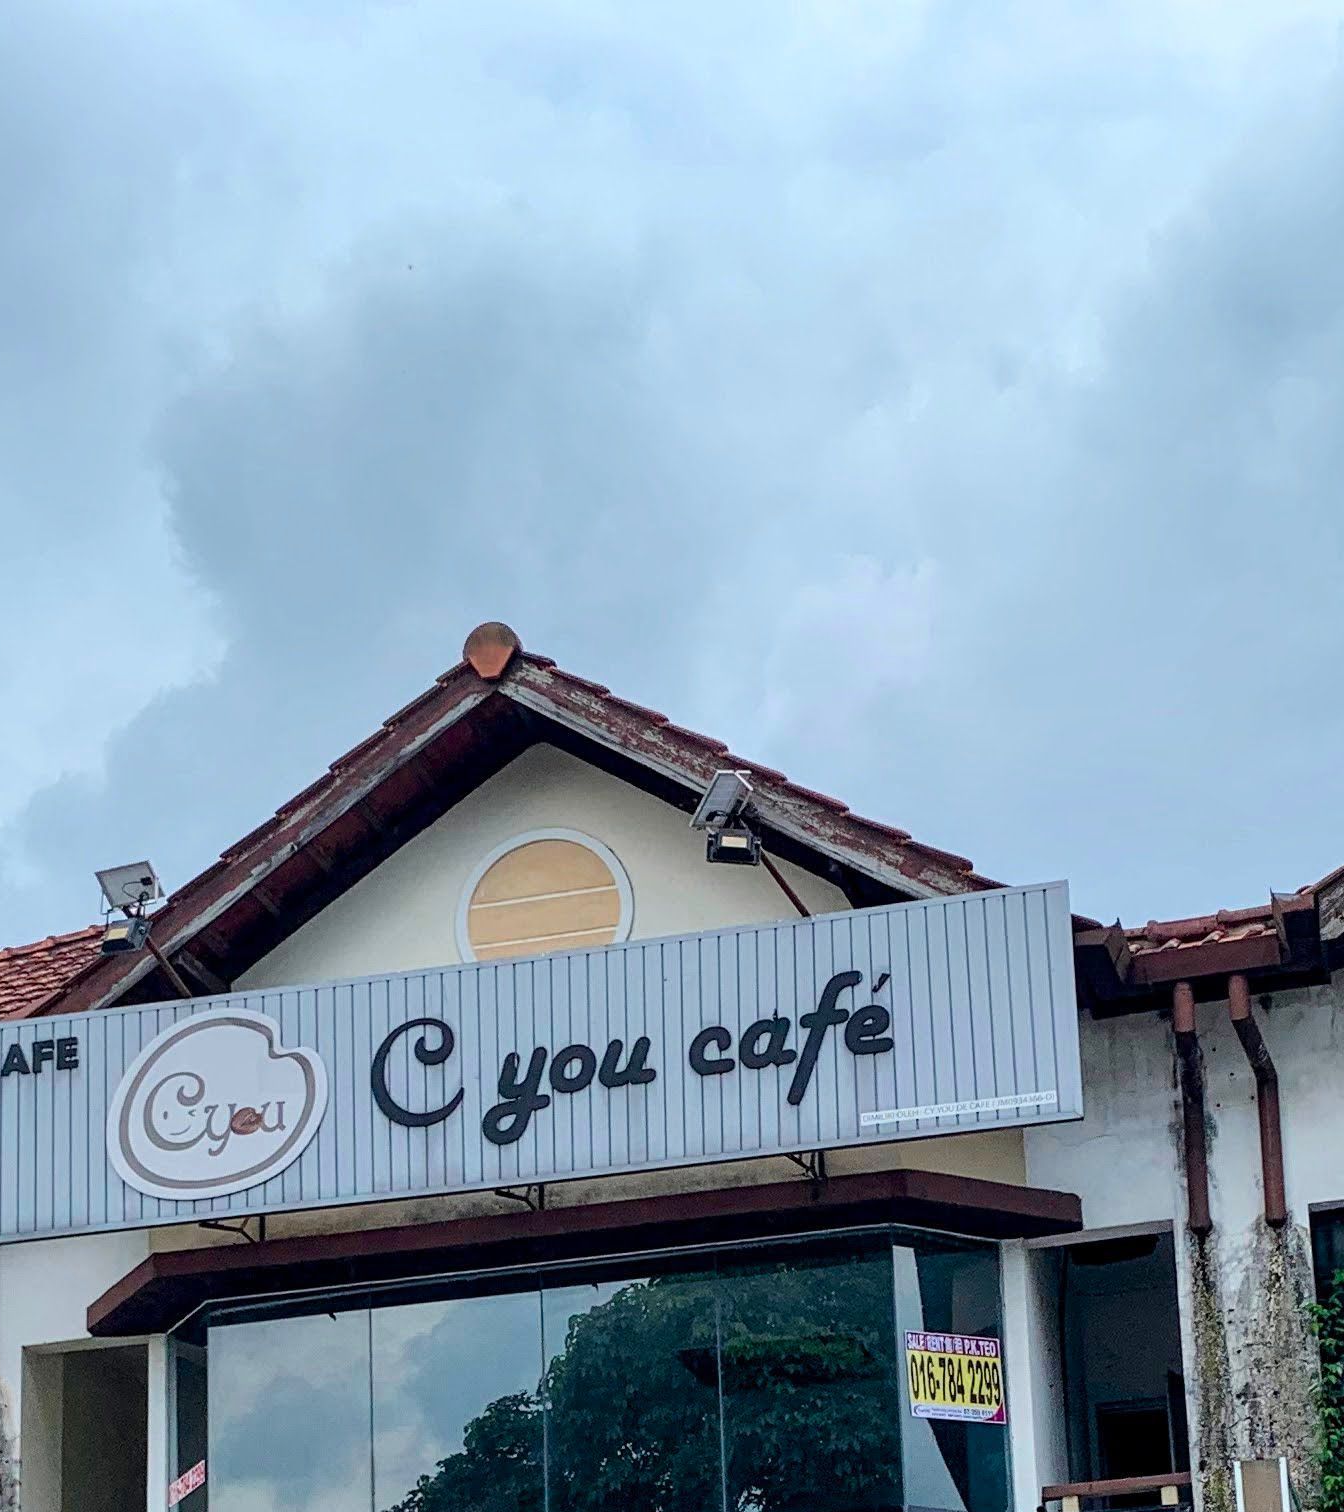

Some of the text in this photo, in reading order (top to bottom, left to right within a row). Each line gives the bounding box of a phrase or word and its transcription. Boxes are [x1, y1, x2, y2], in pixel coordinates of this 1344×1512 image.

[372, 970, 895, 1146] C you café
[910, 1354, 1002, 1407] 016-784 2299
